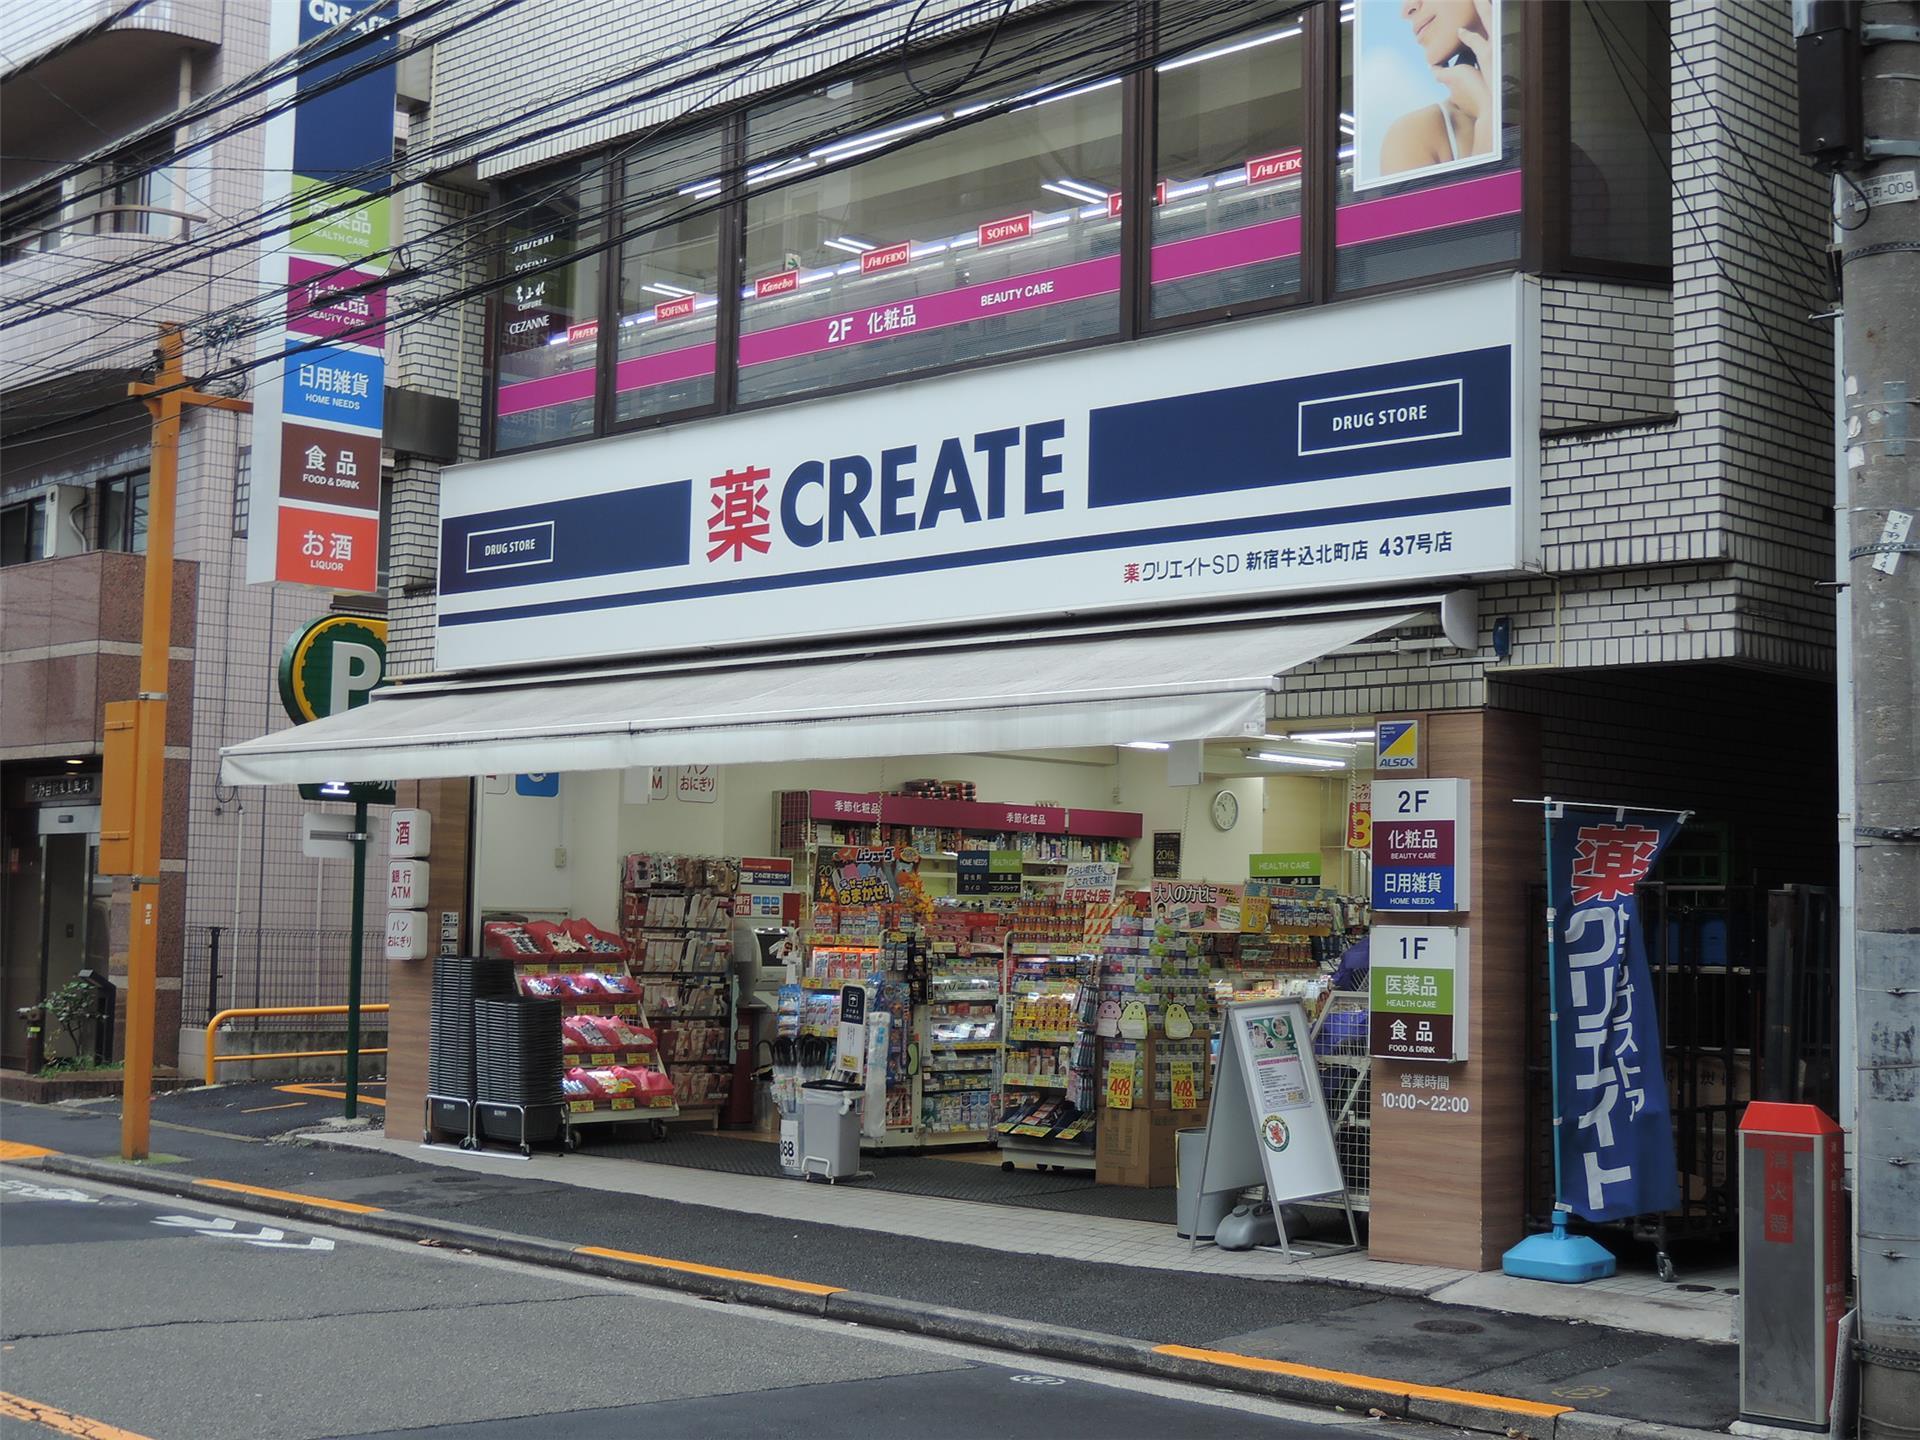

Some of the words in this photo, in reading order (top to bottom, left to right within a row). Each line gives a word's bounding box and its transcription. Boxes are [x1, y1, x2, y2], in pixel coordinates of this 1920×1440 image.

[987, 222, 1023, 239] SOFINA
[346, 234, 370, 248] CARE
[866, 251, 905, 269] SHISEIDO
[762, 278, 794, 294] Kanebo
[661, 303, 689, 318] SOFINA
[828, 319, 852, 343] 2F
[867, 304, 916, 335] 化粧品
[980, 287, 1023, 307] BEAUTY
[1024, 281, 1054, 299] CARE
[509, 315, 550, 334] CEZANNE
[299, 363, 368, 398] 日用雑貨
[305, 392, 331, 406] HOME
[332, 396, 361, 410] NEEDS
[1332, 409, 1374, 432] DRUG
[1378, 404, 1428, 426] STORE
[305, 445, 357, 476] 食品
[303, 474, 326, 487] FOOD
[328, 476, 334, 486] &
[336, 477, 360, 490] DRINK
[706, 465, 772, 563] 薬
[780, 419, 1065, 548] CREATE
[303, 530, 352, 561] お酒
[484, 542, 508, 557] DRUG
[509, 538, 536, 554] STORE
[1246, 540, 1369, 571] 新宿牛込北町店
[1379, 531, 1453, 558] 437号店
[310, 560, 344, 572] LIQUOR
[330, 641, 381, 716] P
[1380, 758, 1415, 767] ALSOK
[679, 776, 714, 792] おにぎり
[834, 800, 880, 814] 季節化粧品
[1398, 790, 1429, 813] 2F
[1006, 812, 1046, 825] 季節化粧品
[396, 821, 410, 846] 酒
[1388, 829, 1438, 849] 化粧品
[856, 847, 895, 862] ムシューダ
[1391, 852, 1416, 860] BEAUTY
[1418, 852, 1436, 860] CARE
[1259, 862, 1289, 870] HEALTH
[1290, 861, 1311, 869] CARE
[1572, 824, 1660, 905] 薬
[391, 870, 411, 884] 銀行
[1384, 872, 1442, 893] 日用雑貨
[391, 887, 411, 898] ATM
[1154, 882, 1217, 904] 大人のカゼに
[1390, 897, 1410, 905] HOME
[392, 920, 409, 931] パン
[387, 936, 412, 948] おにぎり
[1400, 937, 1428, 959] 1F
[1385, 975, 1438, 997] 医薬品
[1386, 1000, 1415, 1008] HEALTH
[1390, 1019, 1433, 1042] 食品
[1389, 1044, 1407, 1053] FOOD
[1415, 1046, 1435, 1054] DRINK
[1564, 906, 1632, 1210] クリエイト
[1110, 1078, 1131, 1096] 498
[1174, 1079, 1192, 1097] 498
[1400, 1073, 1449, 1090] 営業時間
[1770, 1150, 1788, 1234] 消火器
